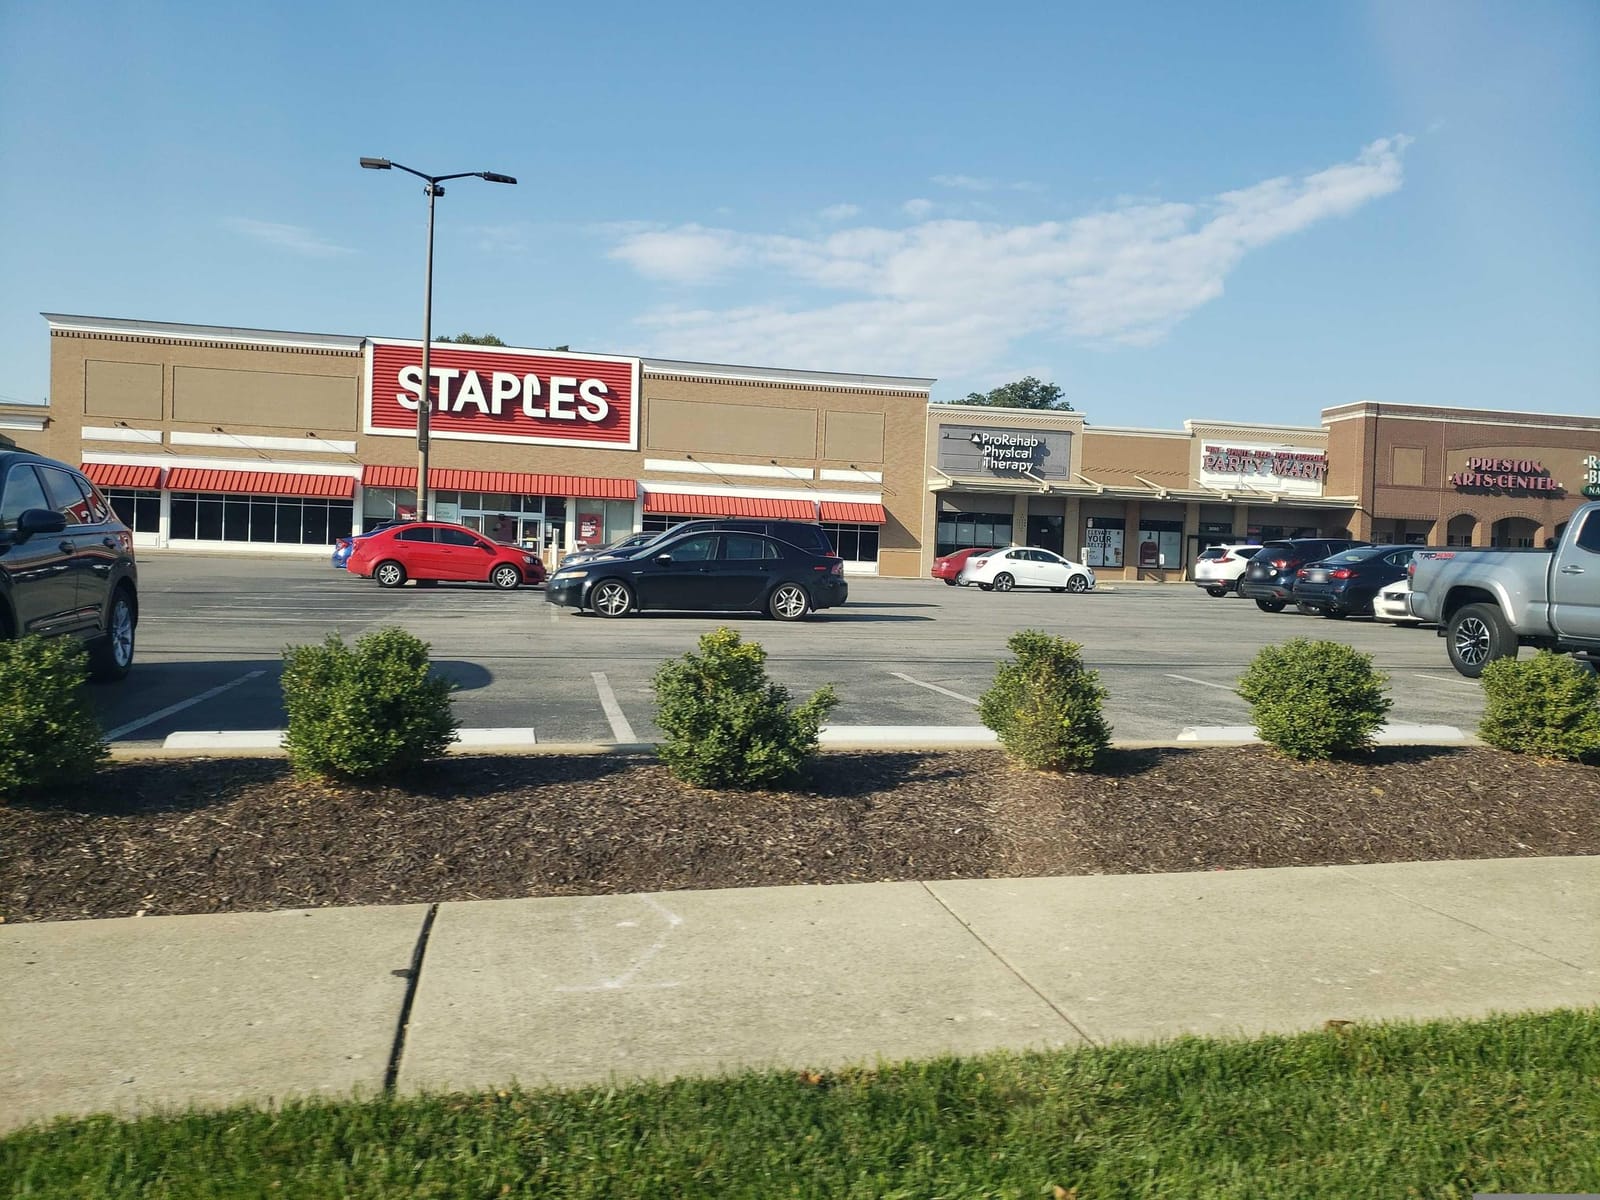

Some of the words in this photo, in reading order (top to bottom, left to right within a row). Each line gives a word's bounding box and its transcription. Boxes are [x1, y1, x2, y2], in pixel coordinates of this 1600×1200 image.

[396, 365, 609, 422] STAPLES
[981, 433, 1038, 447] ProRehab
[983, 445, 1032, 459] Physical
[983, 457, 1033, 473] Therapy
[1203, 455, 1264, 473] PARTY
[1271, 459, 1327, 479] MART
[1470, 457, 1545, 474] PRESTON
[1589, 455, 1600, 469] R
[1451, 471, 1493, 487] ARTS
[1497, 474, 1557, 491] CENTER
[1589, 470, 1600, 484] B
[1088, 535, 1112, 544] YOUR
